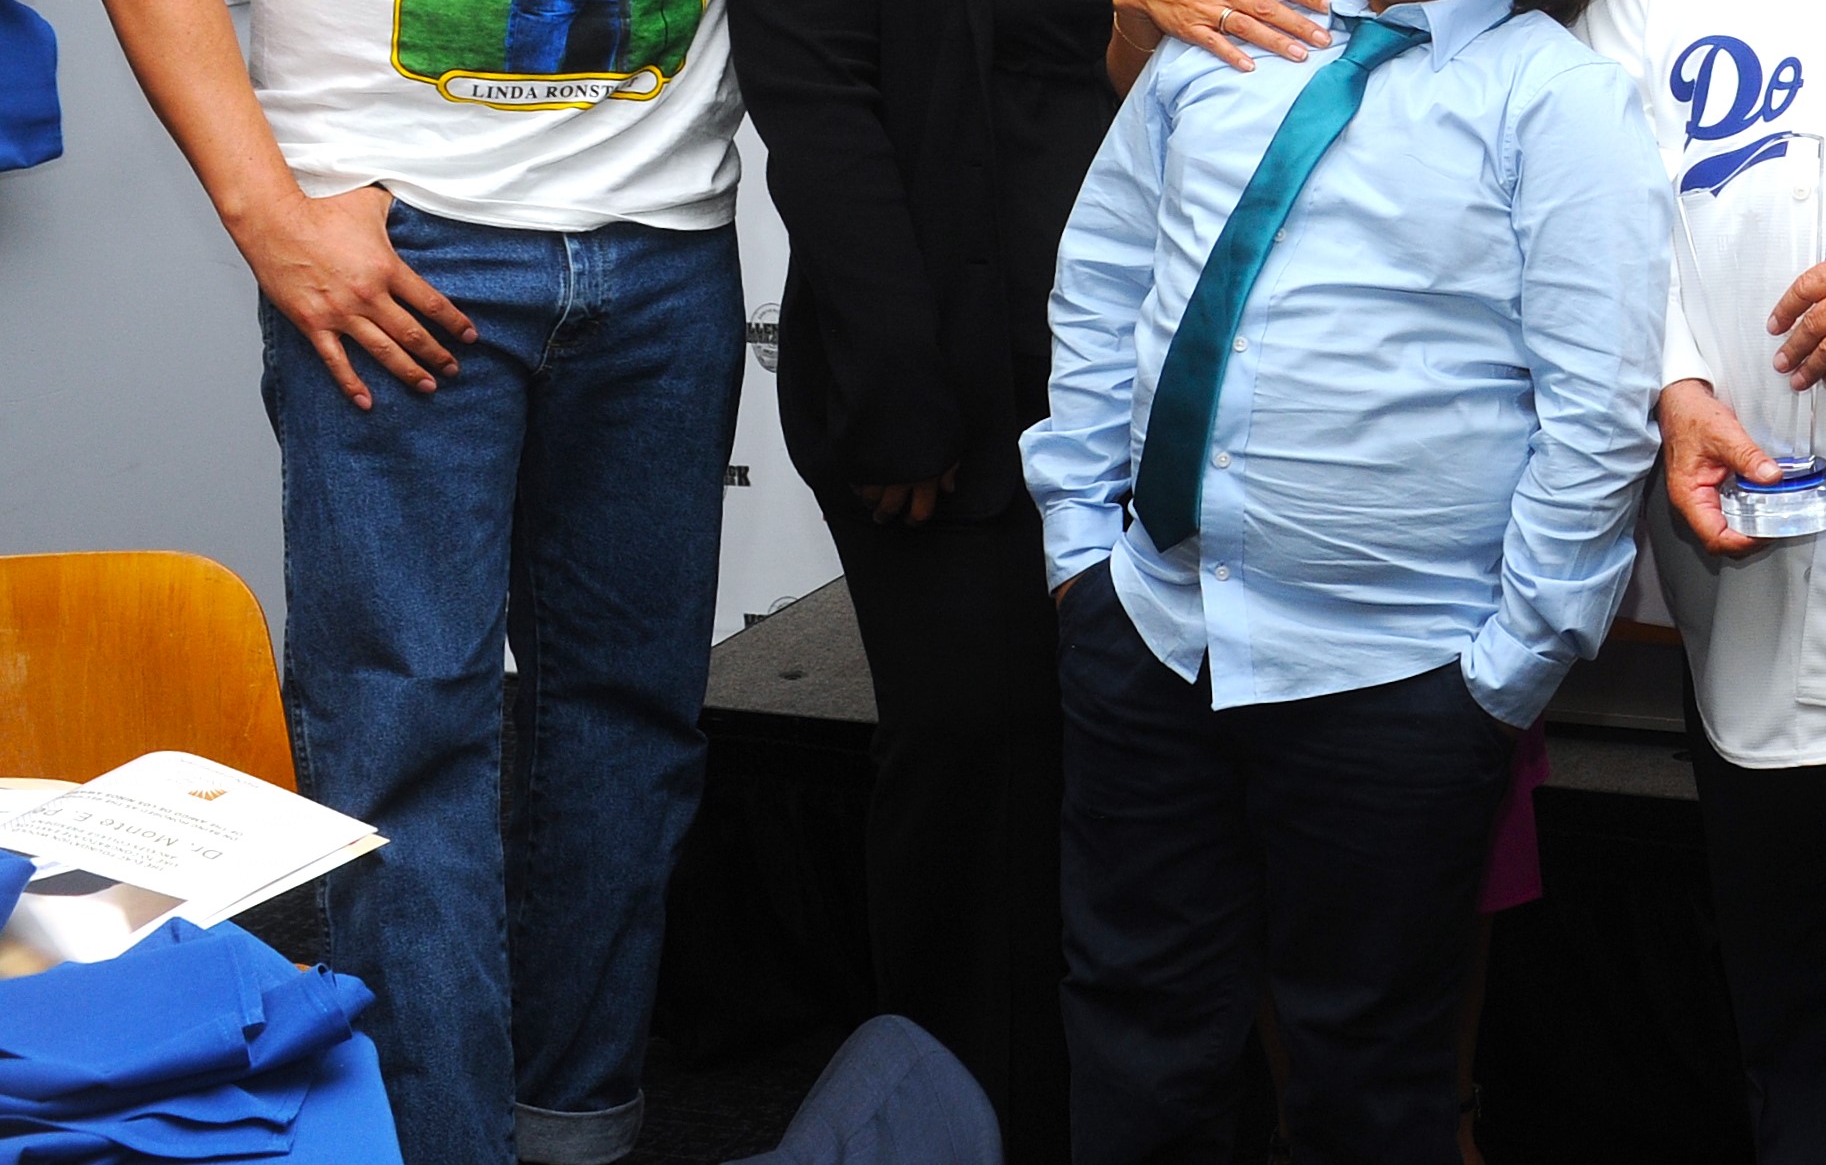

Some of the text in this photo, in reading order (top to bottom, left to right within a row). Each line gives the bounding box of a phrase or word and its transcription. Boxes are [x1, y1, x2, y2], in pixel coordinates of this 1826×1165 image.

[472, 76, 639, 100] LINDA RONSTT
[100, 819, 179, 847] Monte
[191, 843, 223, 860] Dr.
